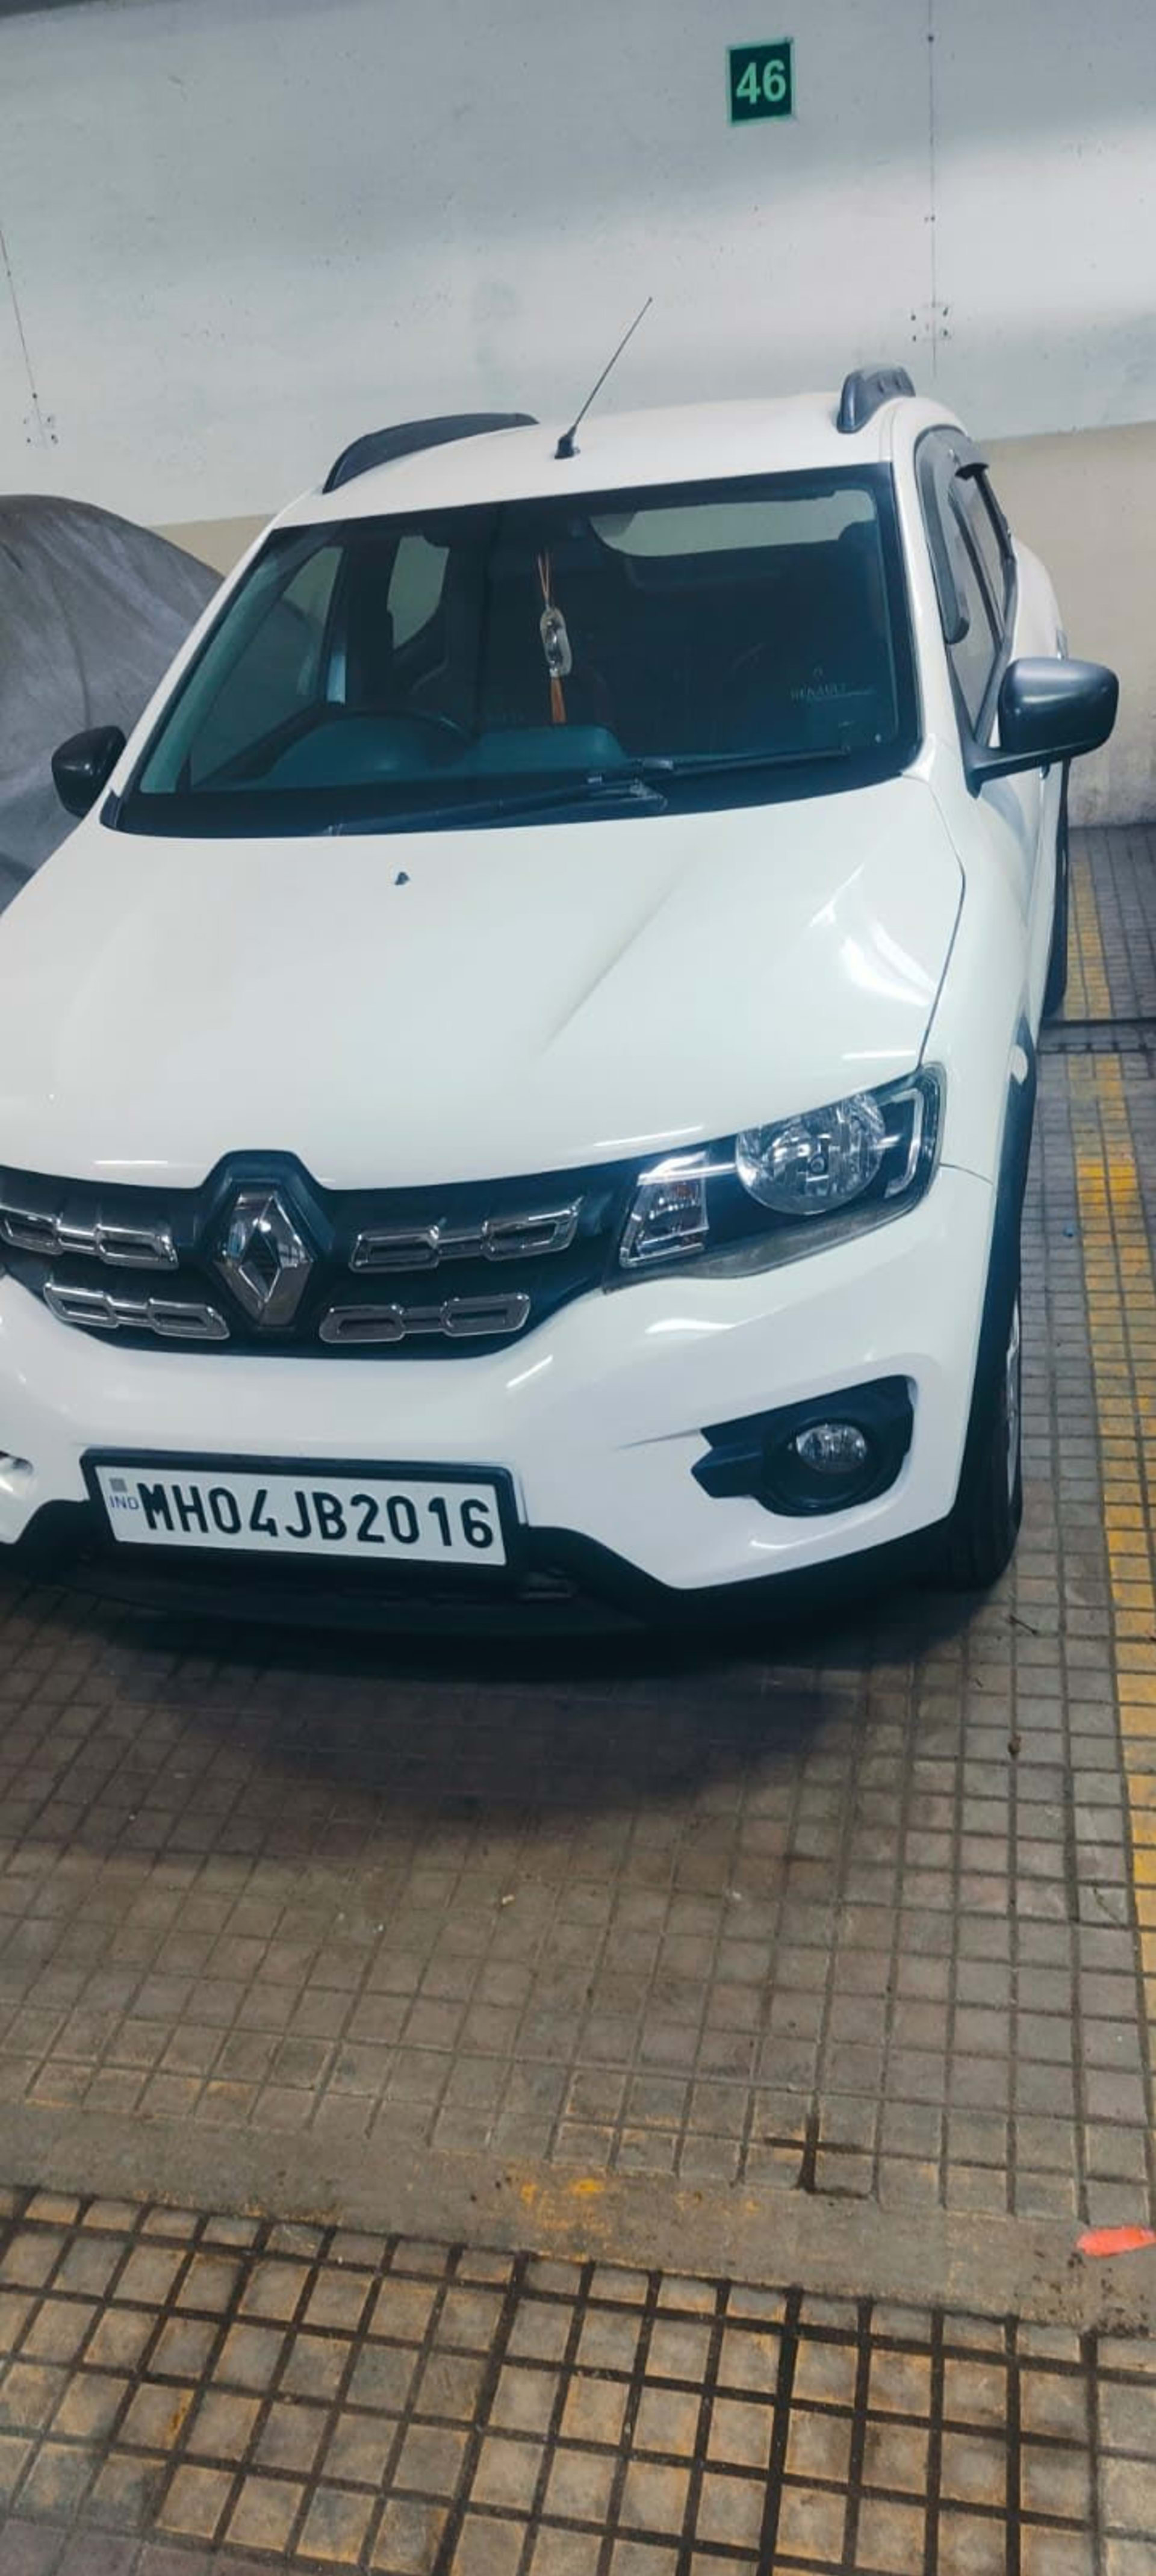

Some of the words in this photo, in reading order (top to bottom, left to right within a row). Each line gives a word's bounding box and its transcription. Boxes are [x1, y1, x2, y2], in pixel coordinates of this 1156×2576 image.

[736, 60, 786, 104] 46
[109, 1495, 139, 1510] IND
[137, 1483, 494, 1548] MH04JB2016
